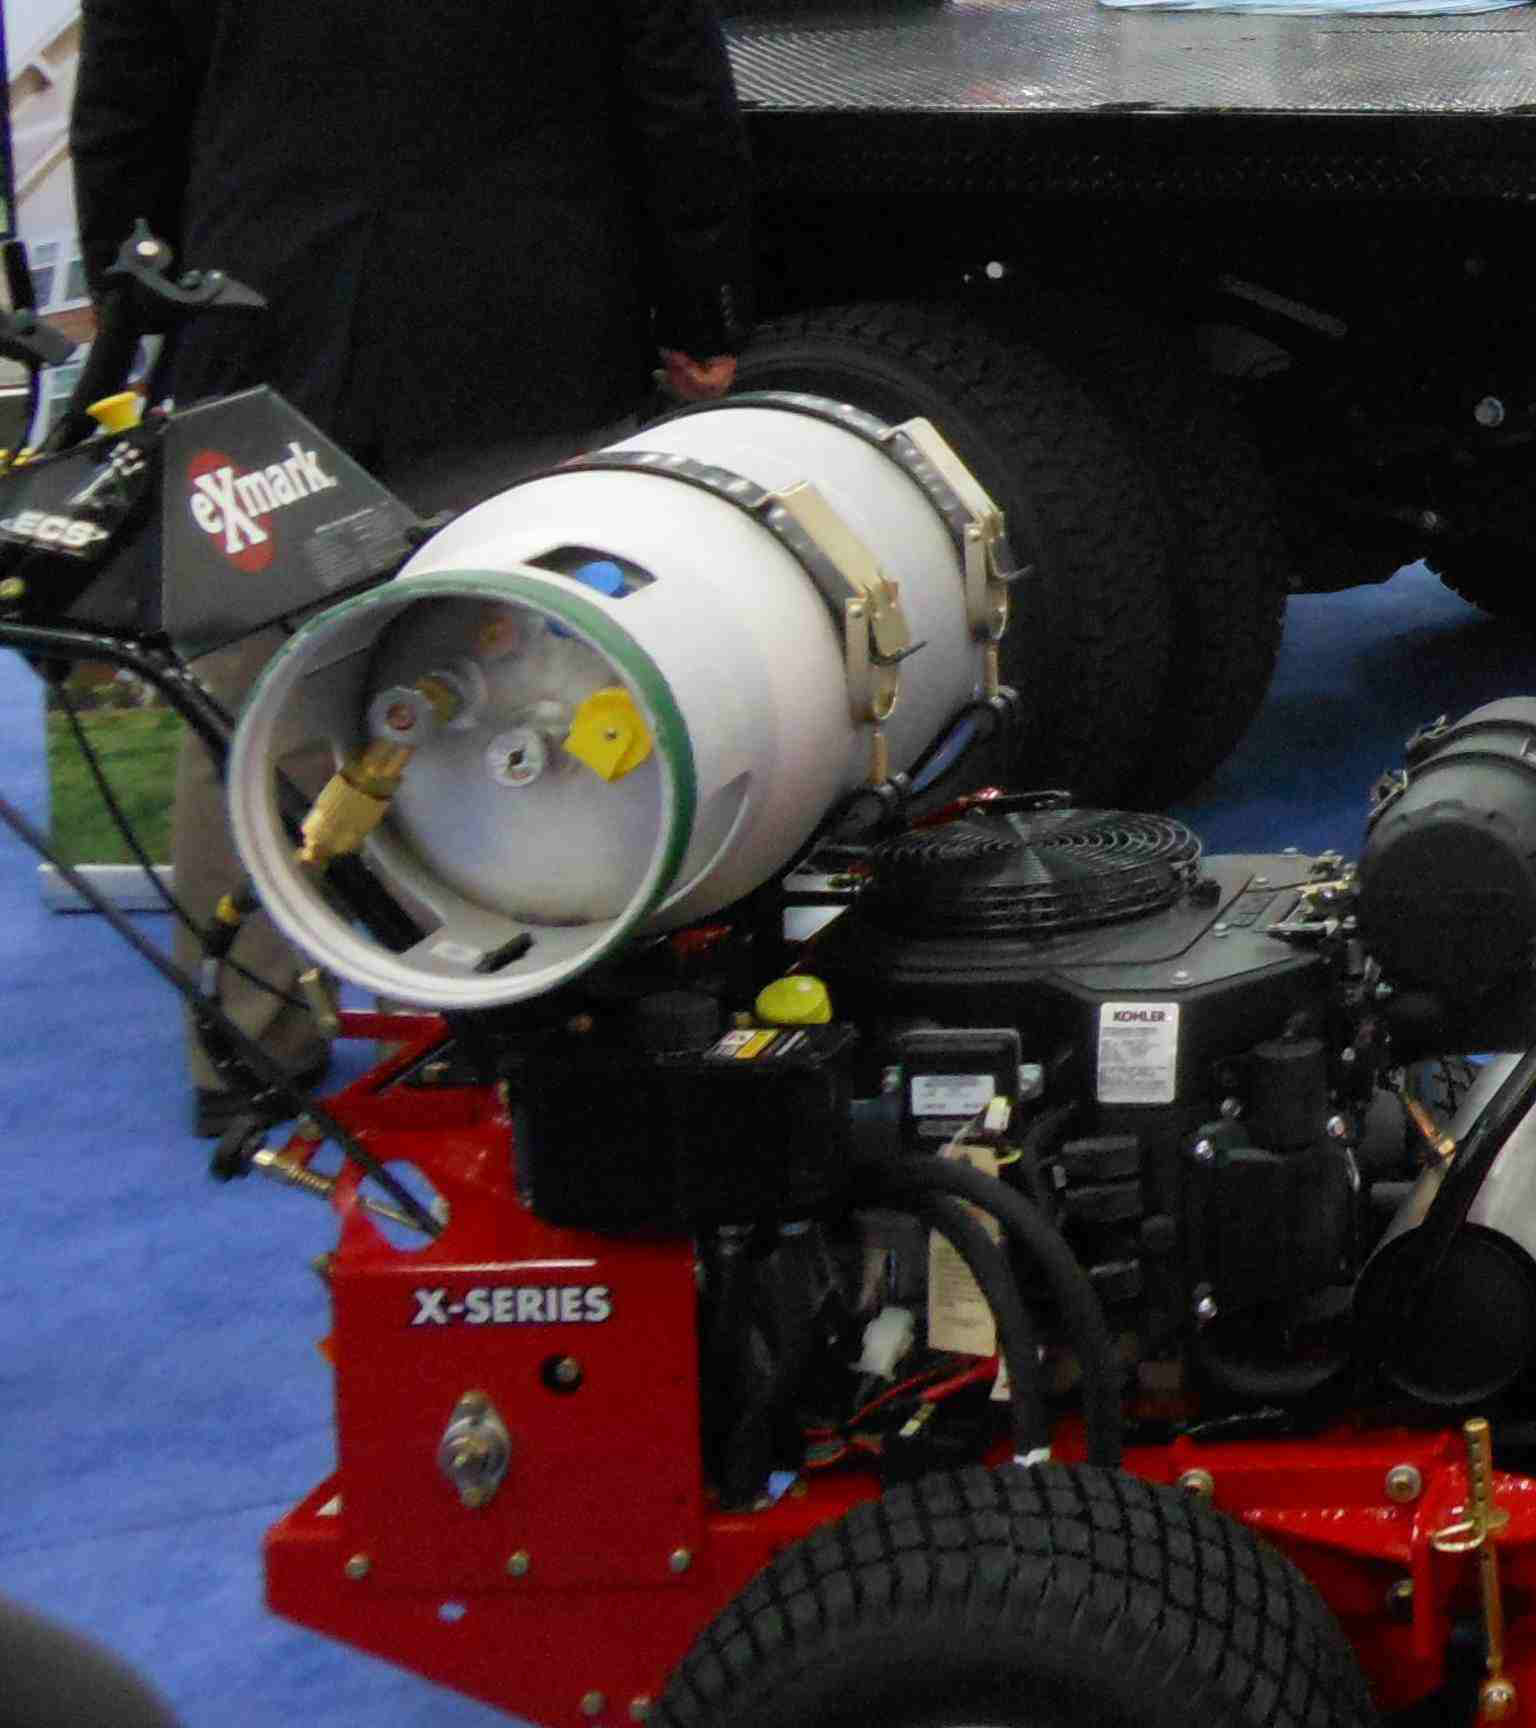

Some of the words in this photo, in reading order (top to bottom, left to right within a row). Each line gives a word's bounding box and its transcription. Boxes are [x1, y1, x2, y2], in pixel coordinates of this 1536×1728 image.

[190, 441, 338, 555] eXmark
[1112, 1011, 1166, 1022] KOHLER
[411, 1286, 613, 1326] X-SERIES
